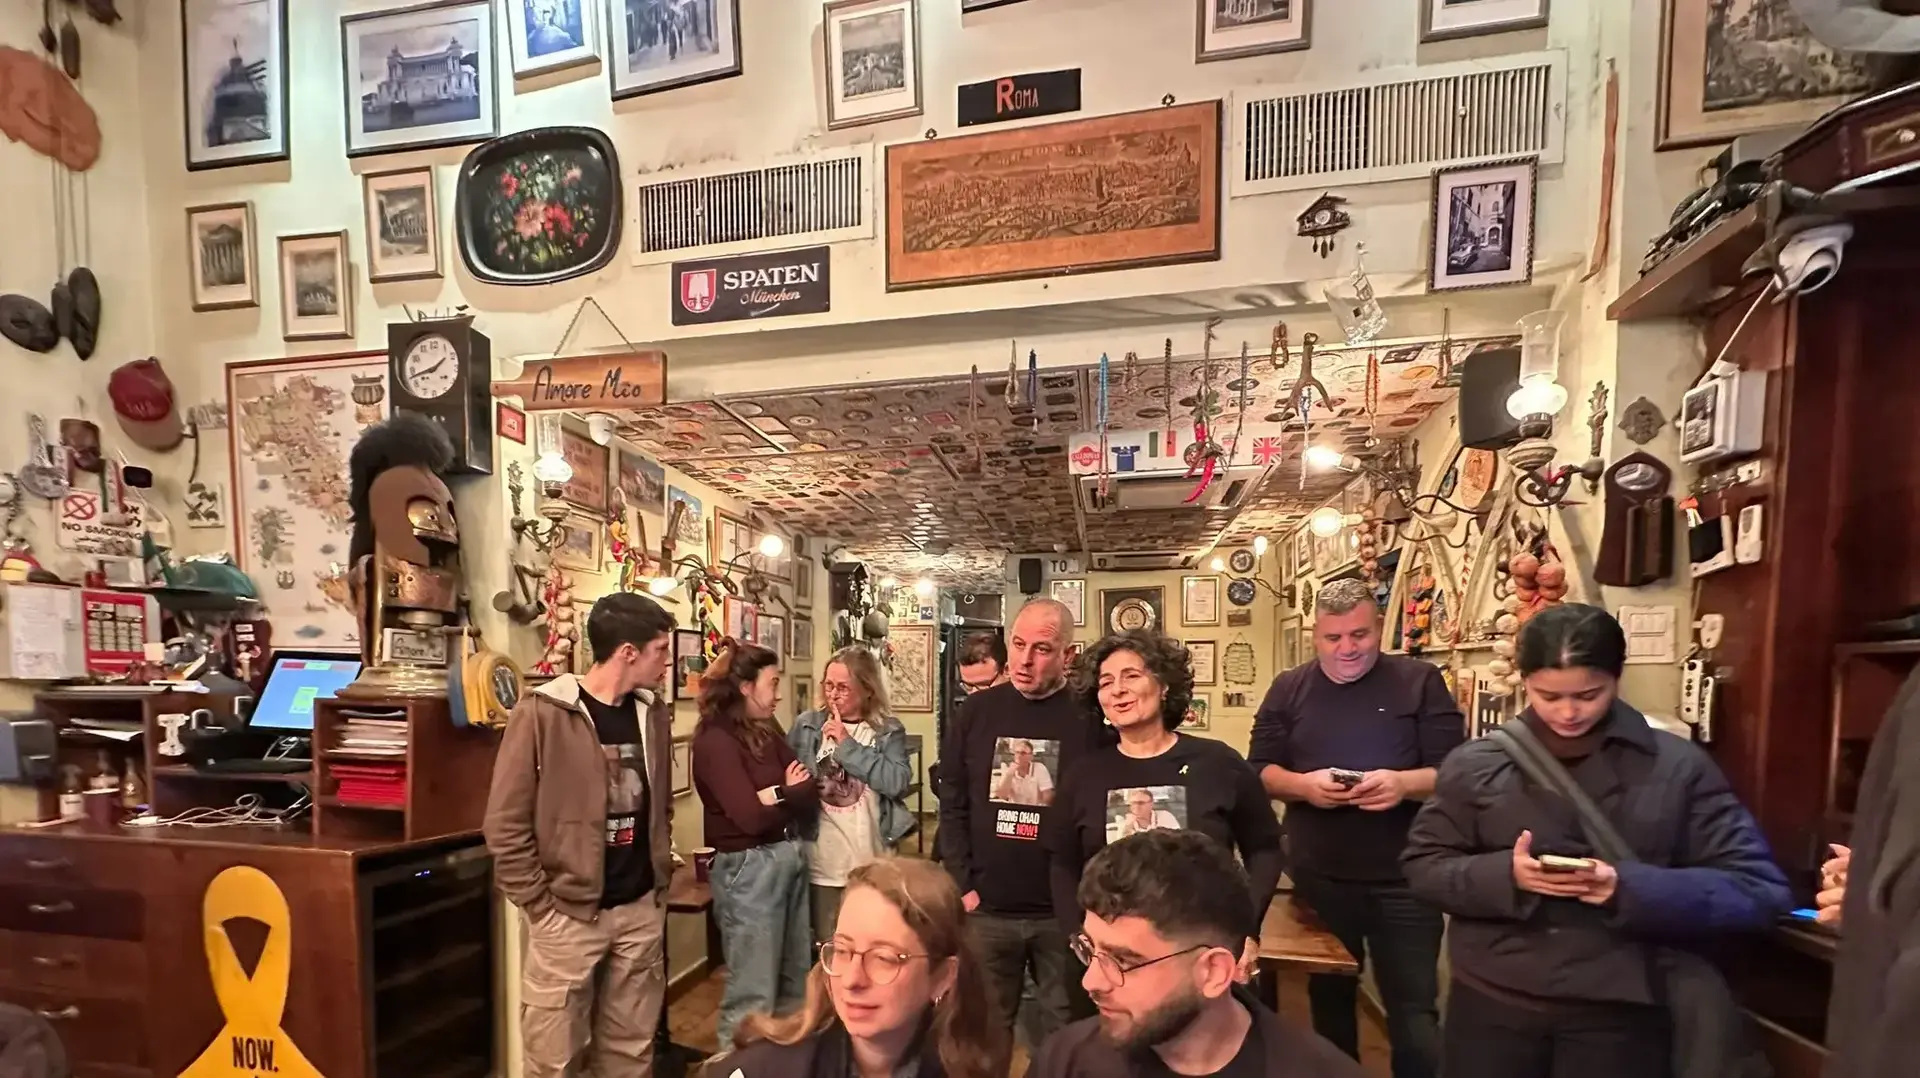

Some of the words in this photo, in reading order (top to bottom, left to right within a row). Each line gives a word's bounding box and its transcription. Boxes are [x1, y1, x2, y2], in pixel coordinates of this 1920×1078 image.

[723, 262, 821, 291] SPATEN
[740, 287, 801, 305] München
[532, 364, 593, 402] Amore
[599, 366, 642, 400] Mio
[61, 521, 82, 532] NO
[85, 525, 144, 541] SMOKING
[997, 809, 1019, 822] BRING
[1018, 811, 1041, 825] OHAD
[996, 821, 1016, 835] HOME
[1015, 823, 1039, 838] NOW!
[231, 1036, 279, 1073] NOW.
